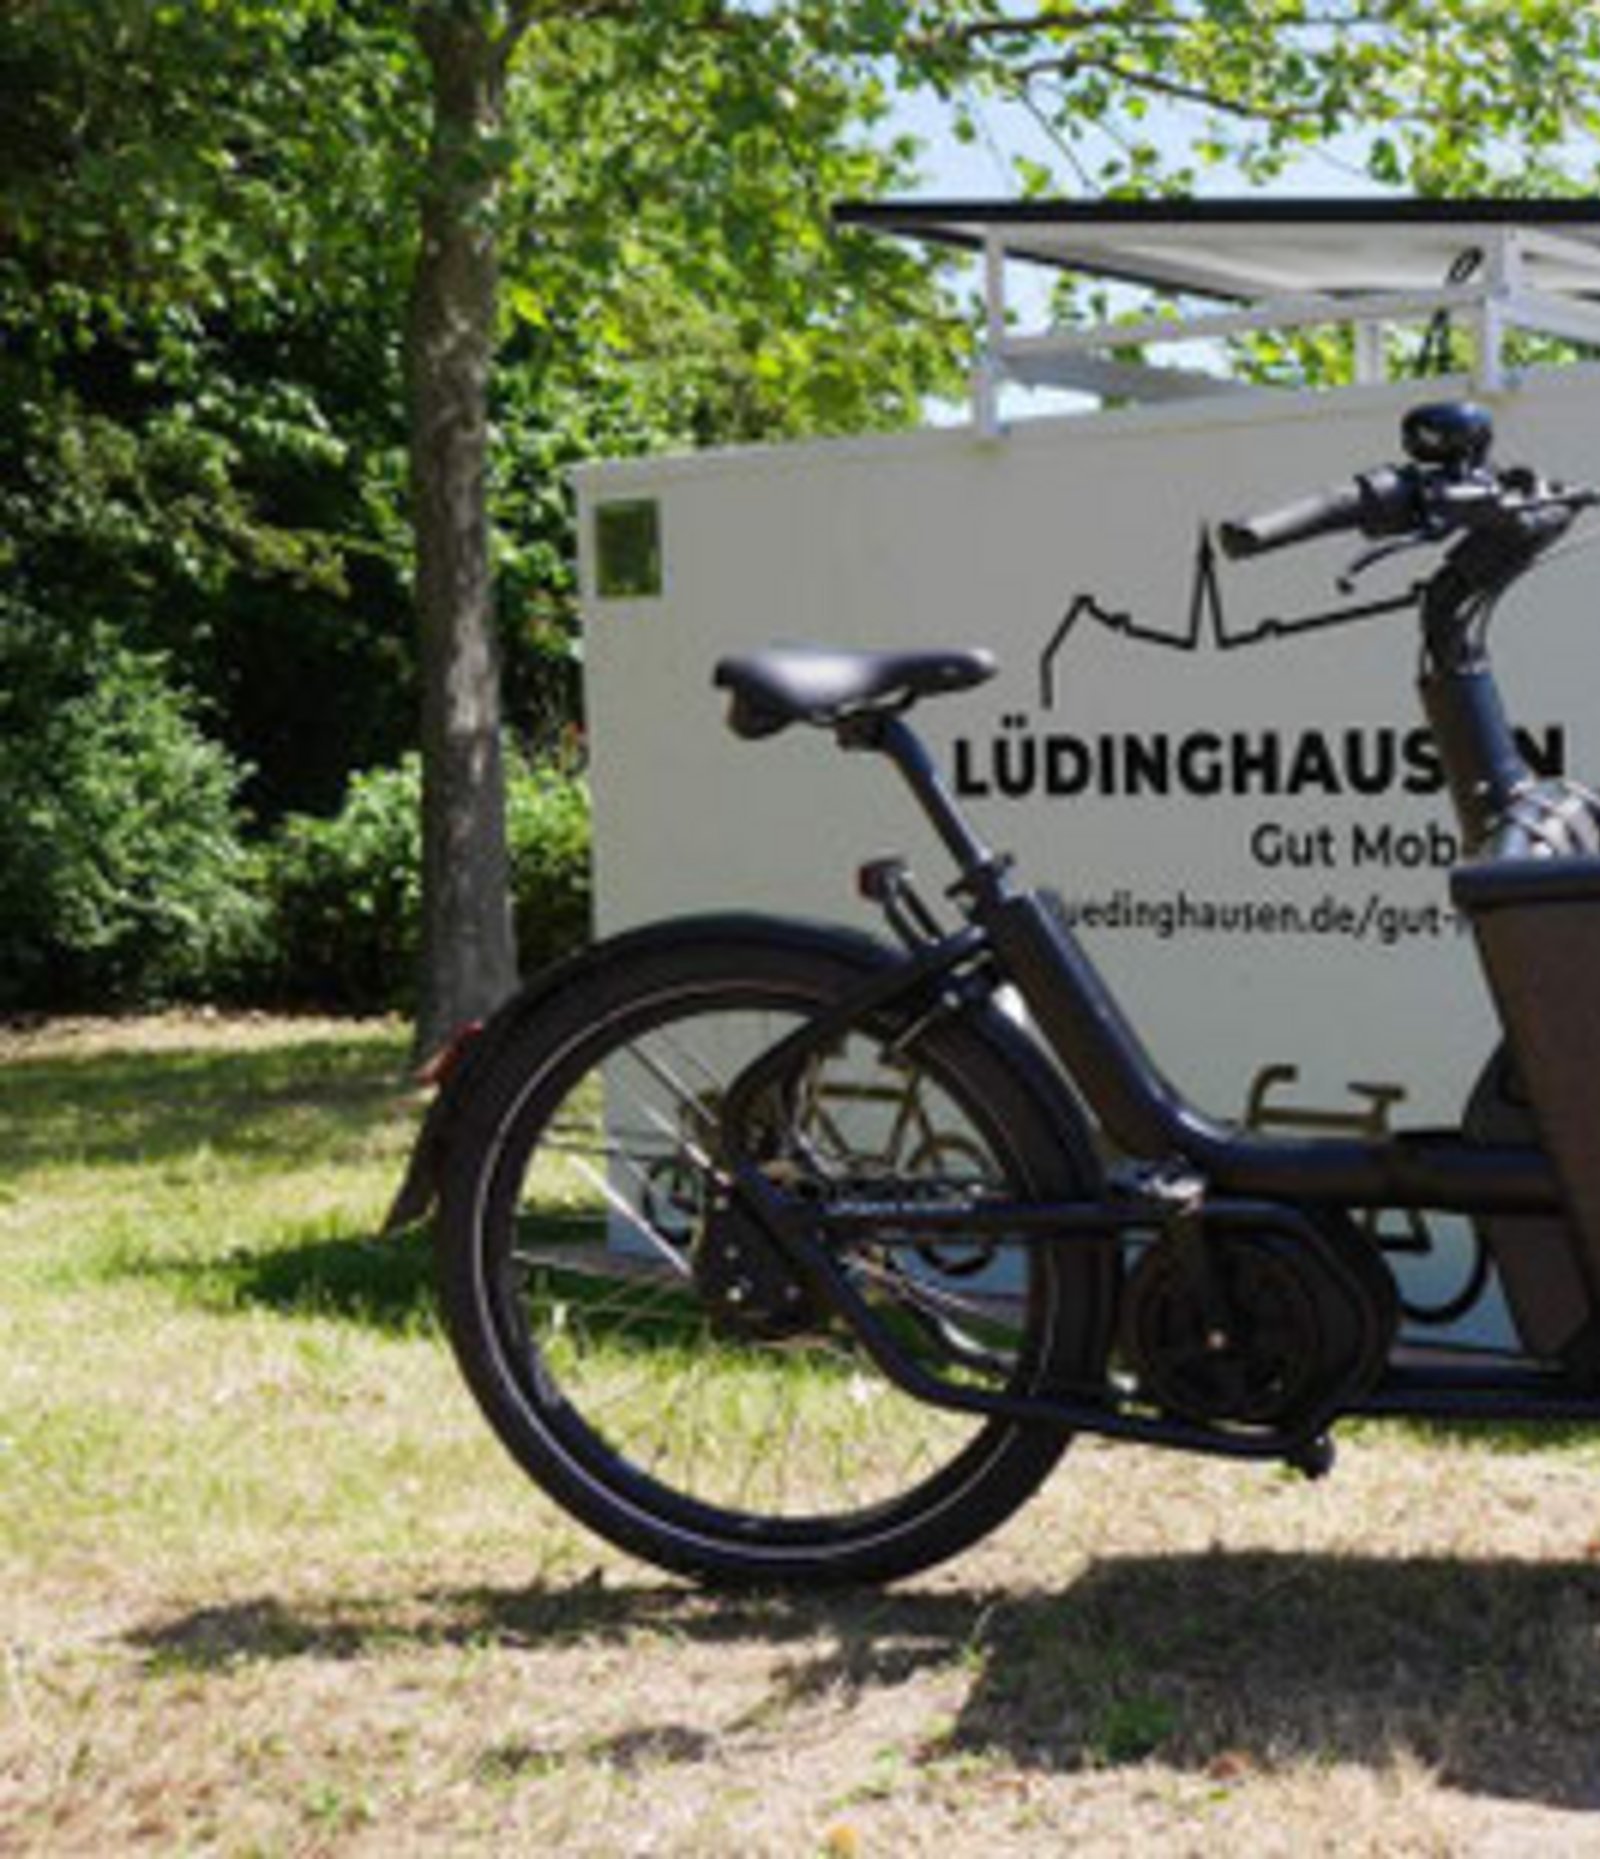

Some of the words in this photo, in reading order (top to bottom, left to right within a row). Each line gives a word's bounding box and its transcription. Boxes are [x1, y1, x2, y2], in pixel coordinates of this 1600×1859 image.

[953, 714, 1565, 797] LÜDINGHAUSN
[1250, 823, 1335, 868] Gut
[1352, 823, 1457, 867] Mob
